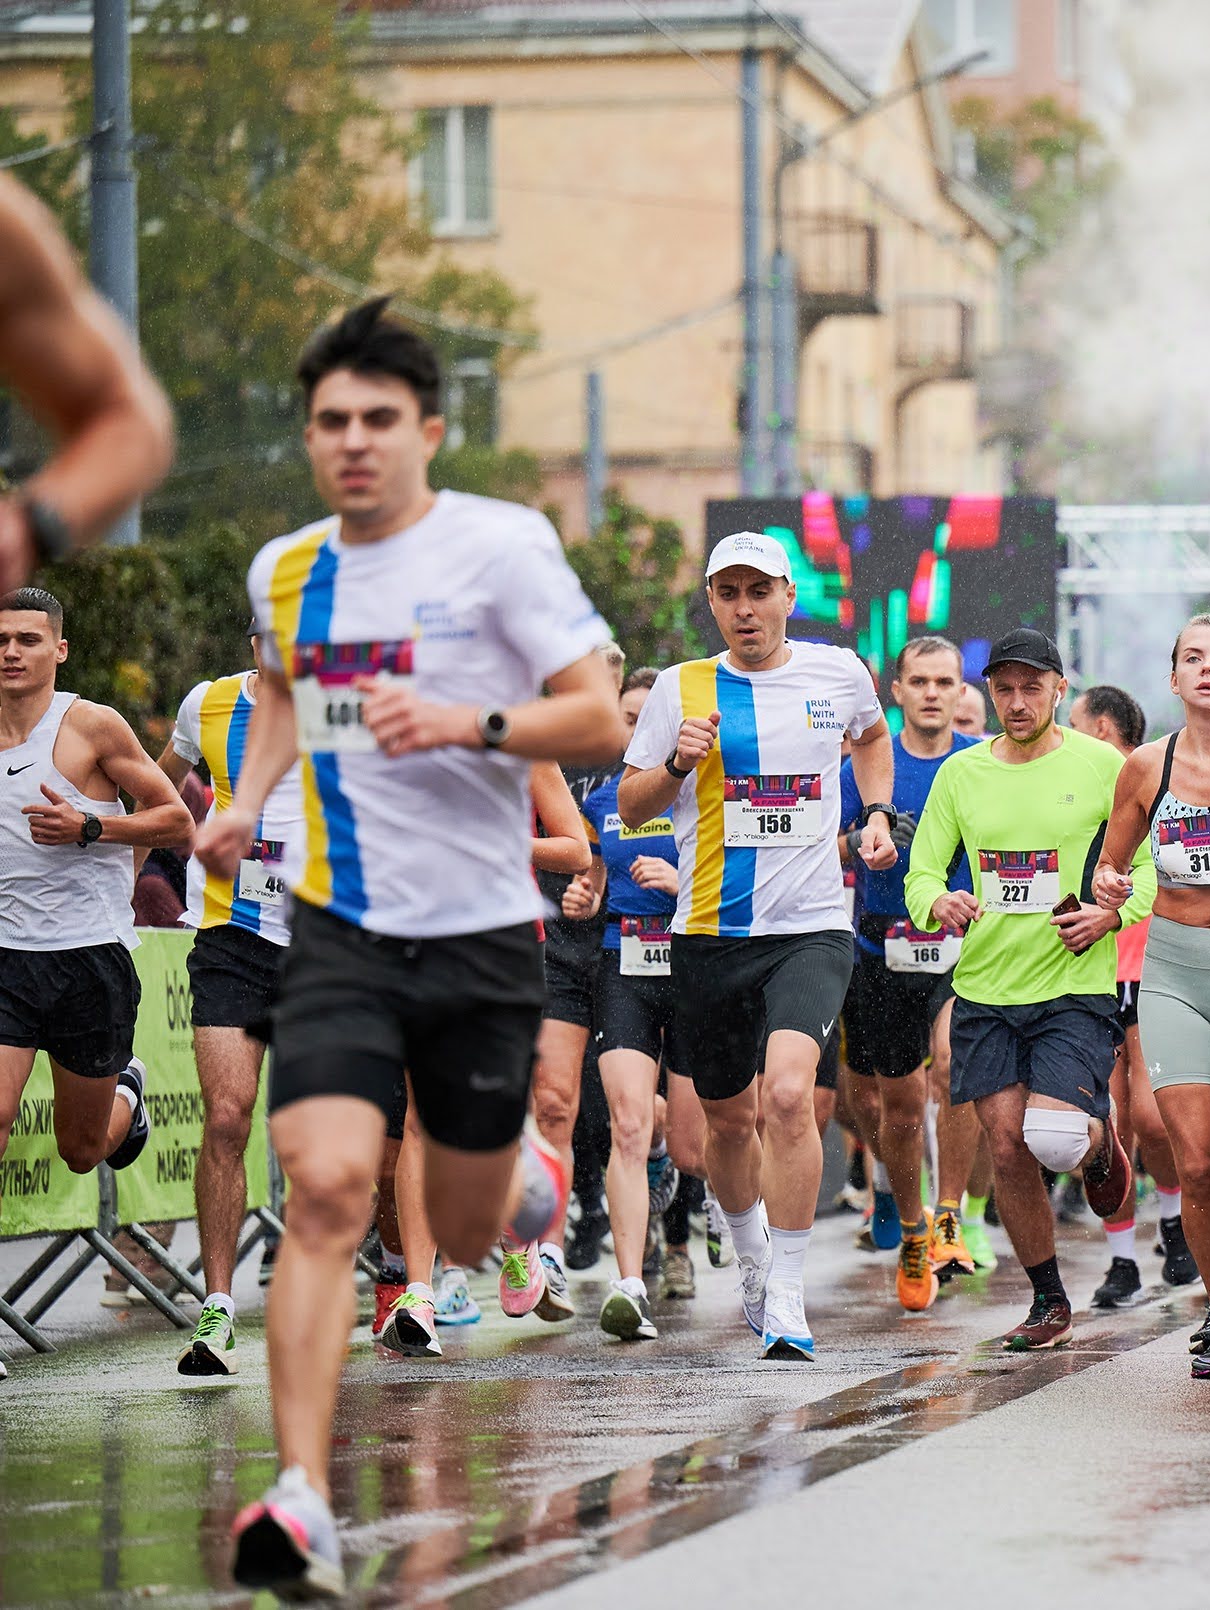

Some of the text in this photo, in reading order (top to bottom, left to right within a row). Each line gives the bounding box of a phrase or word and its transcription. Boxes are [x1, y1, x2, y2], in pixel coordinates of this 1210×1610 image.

[813, 721, 845, 730] UKRAINE
[757, 814, 792, 834] 158
[1170, 821, 1180, 829] KM
[1002, 884, 1029, 901] 227
[643, 948, 671, 963] 440
[913, 947, 940, 963] 166
[32, 1099, 55, 1135] ЖИ
